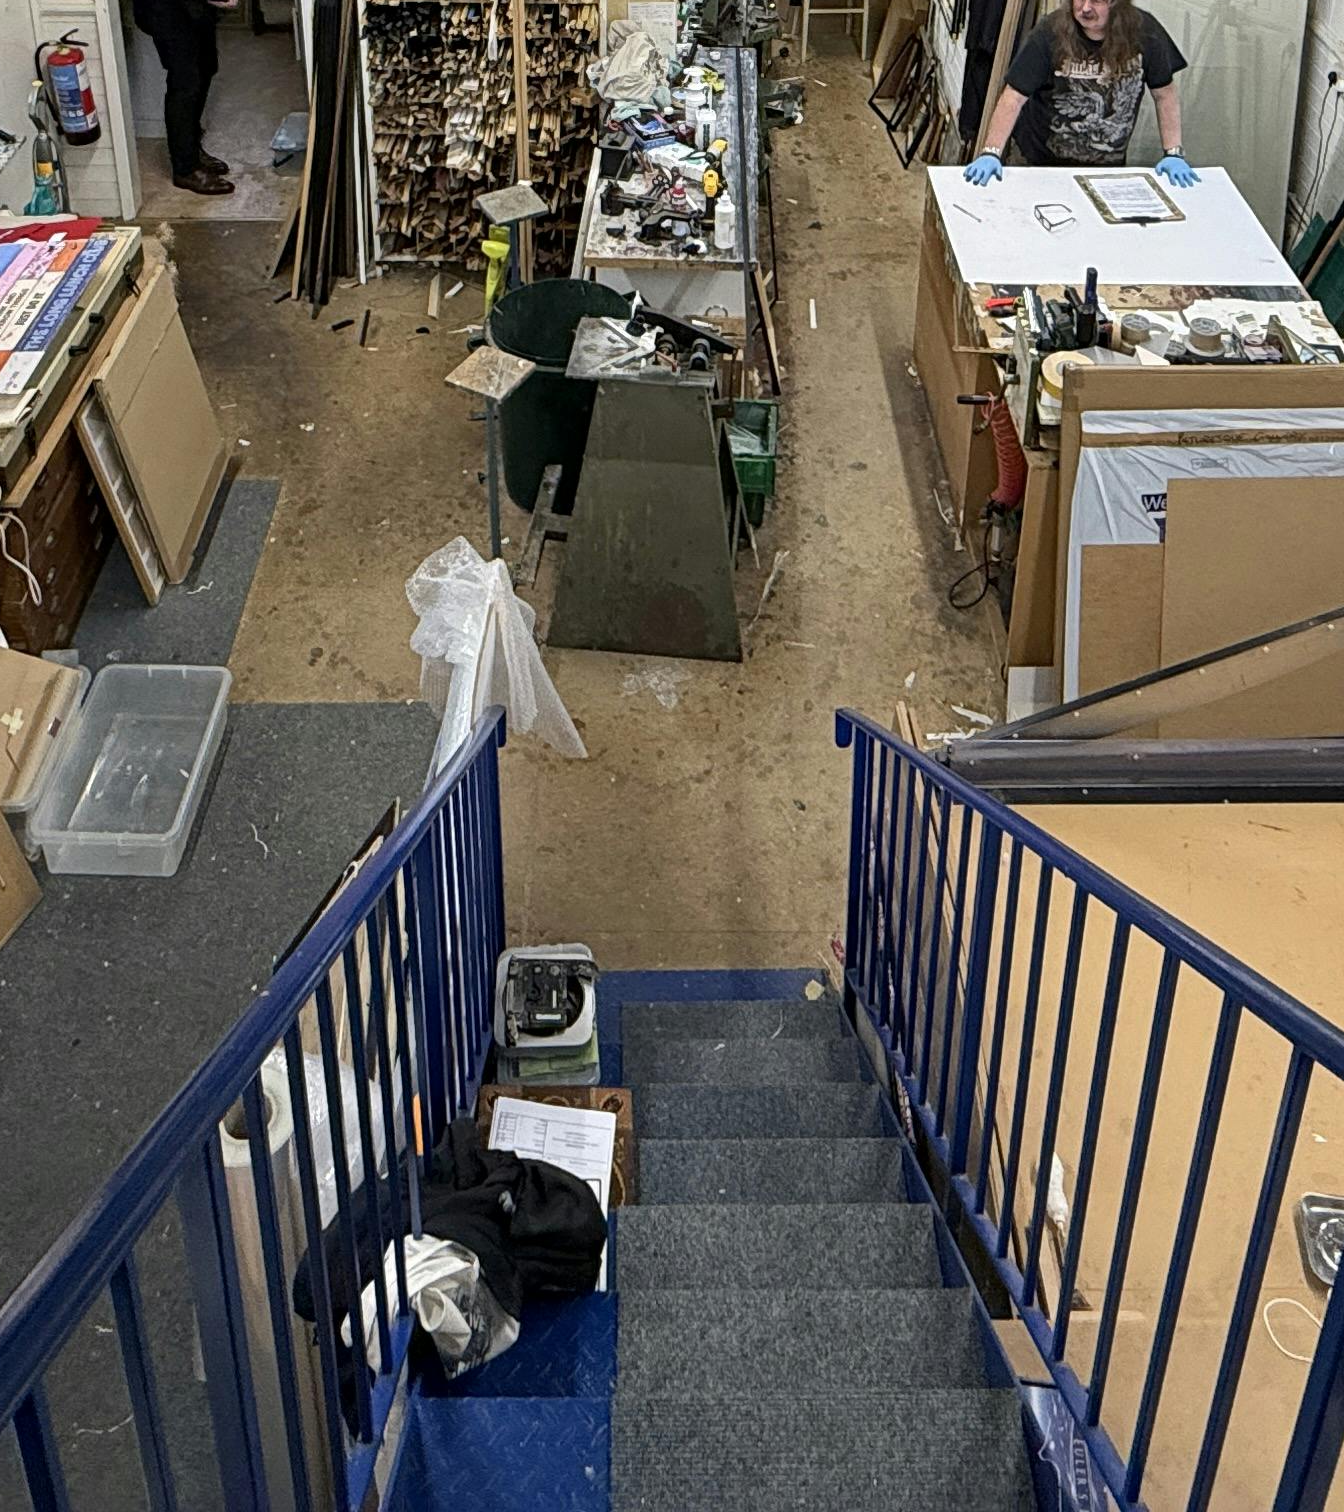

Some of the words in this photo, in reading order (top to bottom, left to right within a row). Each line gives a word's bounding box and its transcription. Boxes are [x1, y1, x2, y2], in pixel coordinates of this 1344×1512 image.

[78, 239, 110, 262] CLUB
[56, 263, 92, 297] LUNCH
[36, 297, 70, 327] LONG
[22, 327, 51, 349] THE
